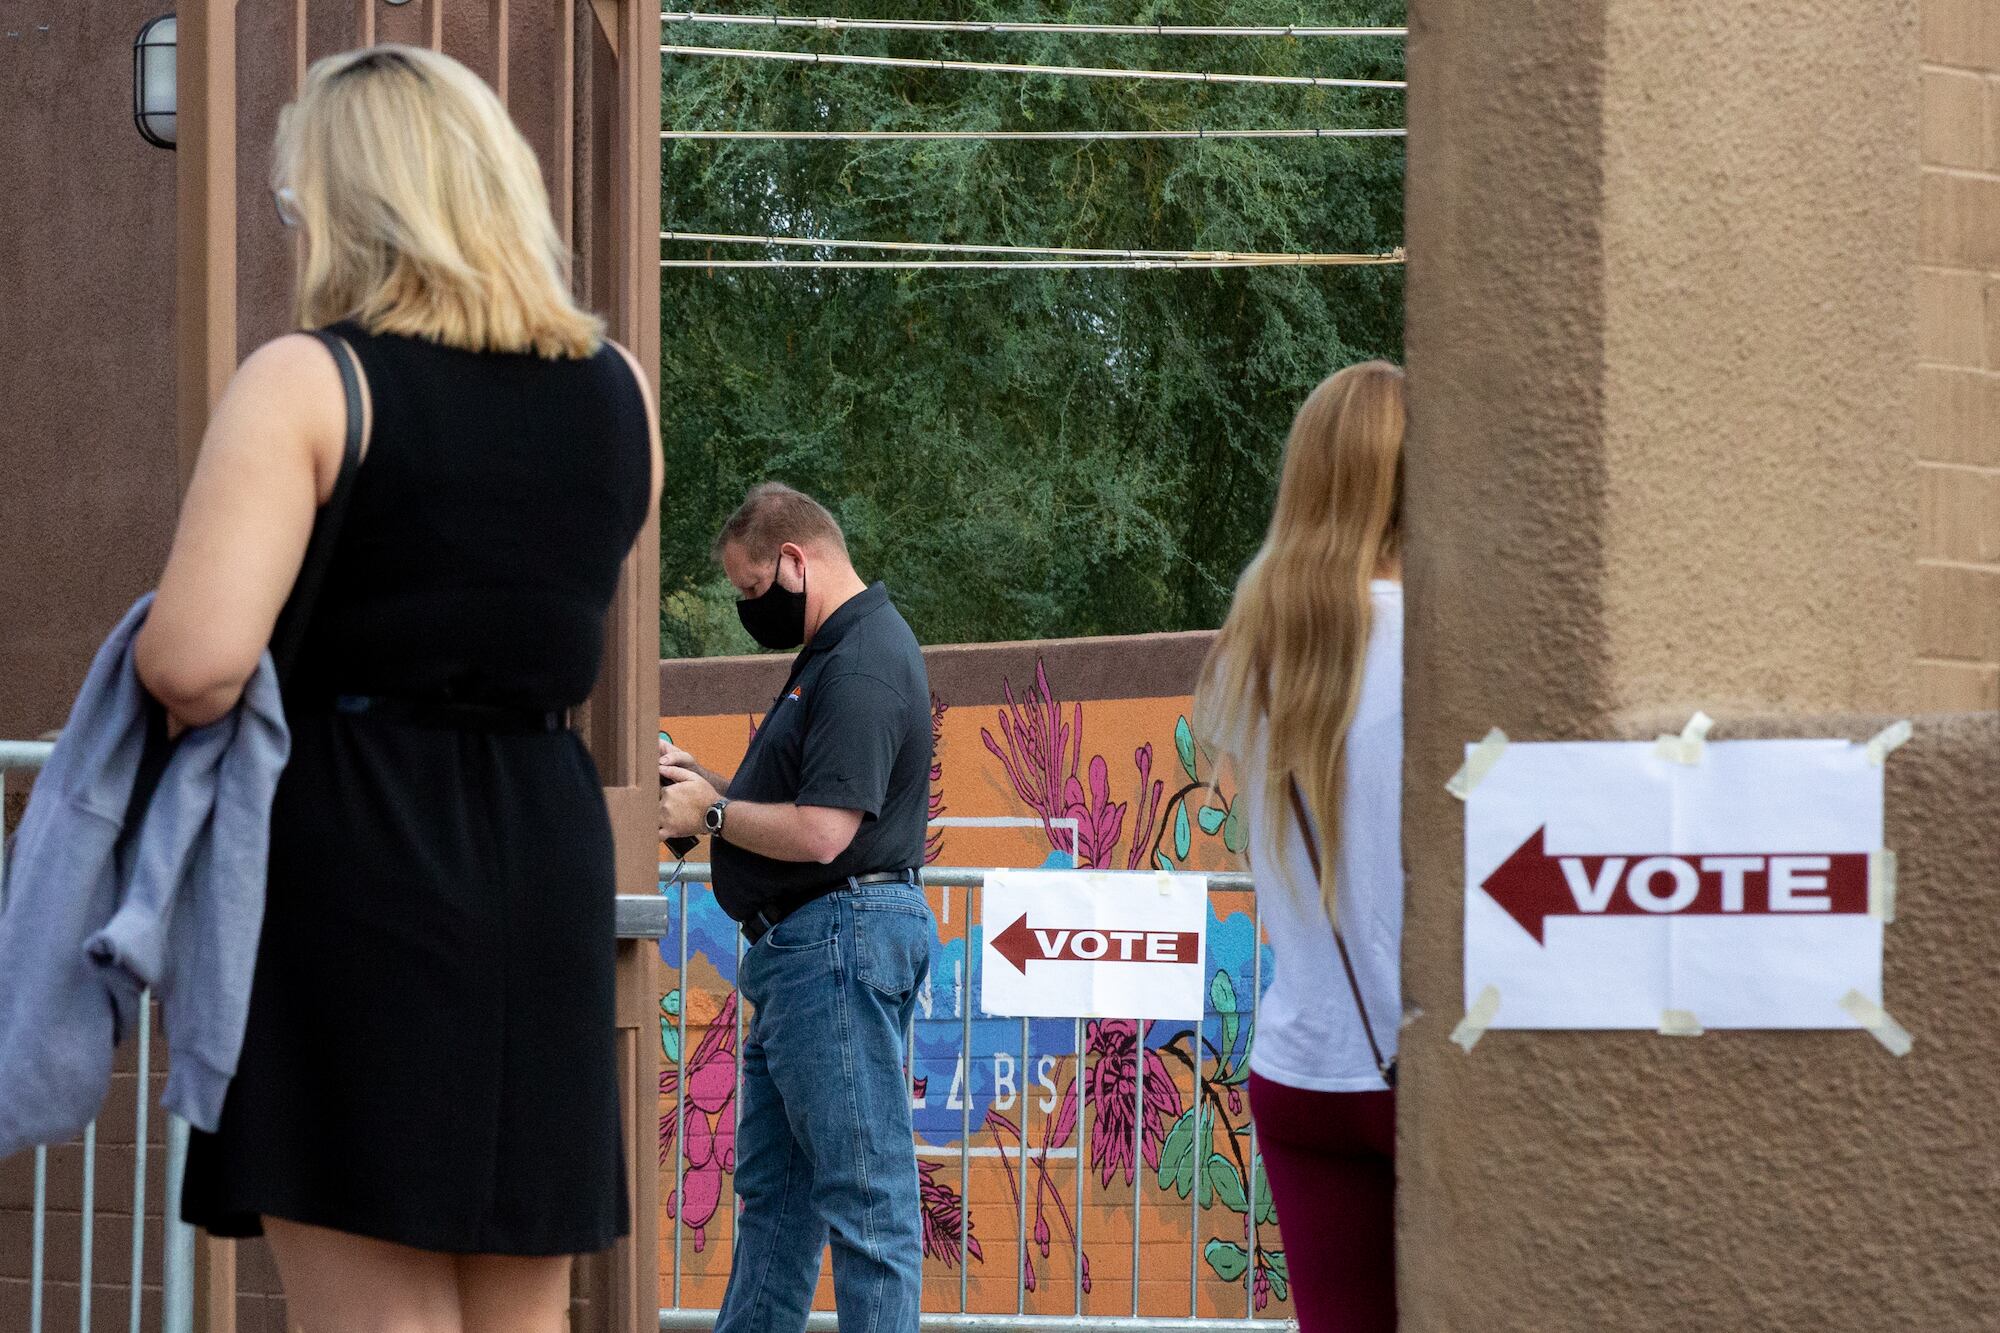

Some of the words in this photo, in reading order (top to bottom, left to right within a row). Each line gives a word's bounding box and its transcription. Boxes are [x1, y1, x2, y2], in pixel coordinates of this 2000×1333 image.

[1559, 856, 1832, 913] VOTE
[1034, 929, 1179, 961] VOTE
[912, 1053, 1056, 1114] ABS
